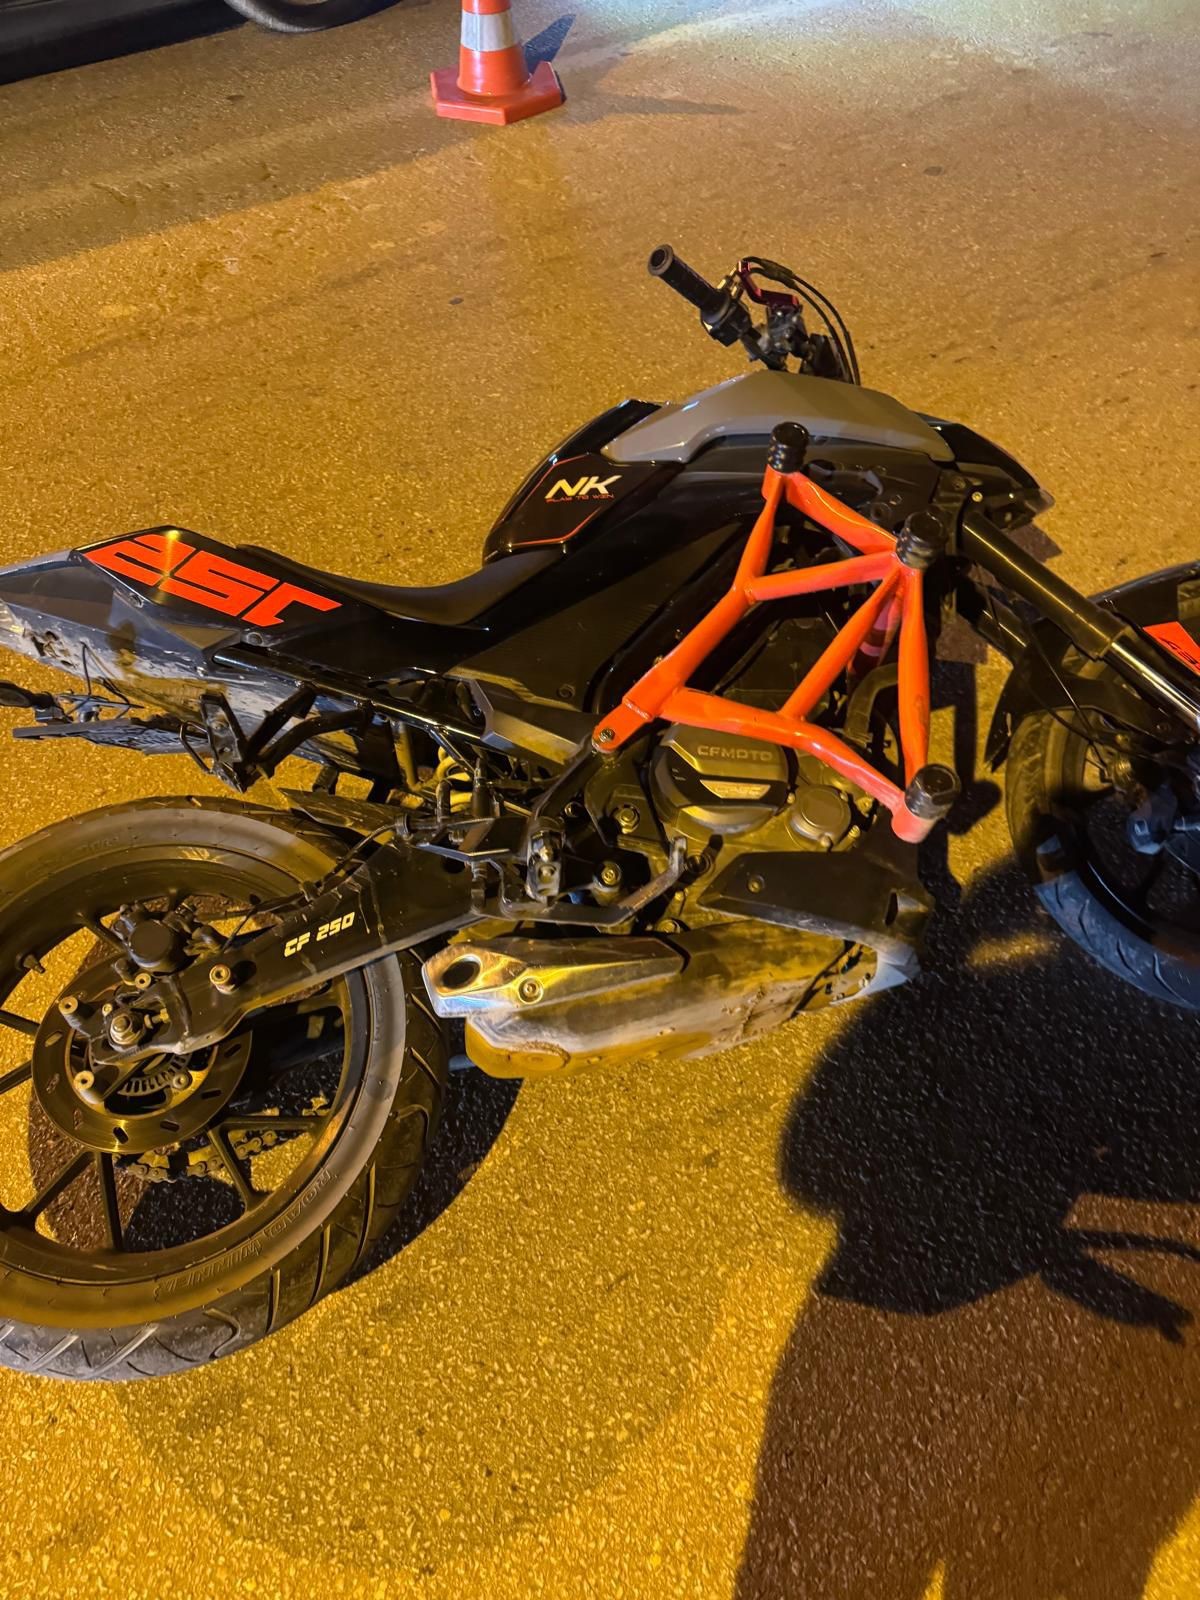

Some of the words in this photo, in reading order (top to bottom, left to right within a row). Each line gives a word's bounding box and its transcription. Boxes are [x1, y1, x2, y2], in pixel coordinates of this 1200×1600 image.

[544, 475, 622, 499] NK
[697, 745, 773, 761] CFMOTO
[284, 931, 311, 957] CF
[316, 911, 355, 941] 250
